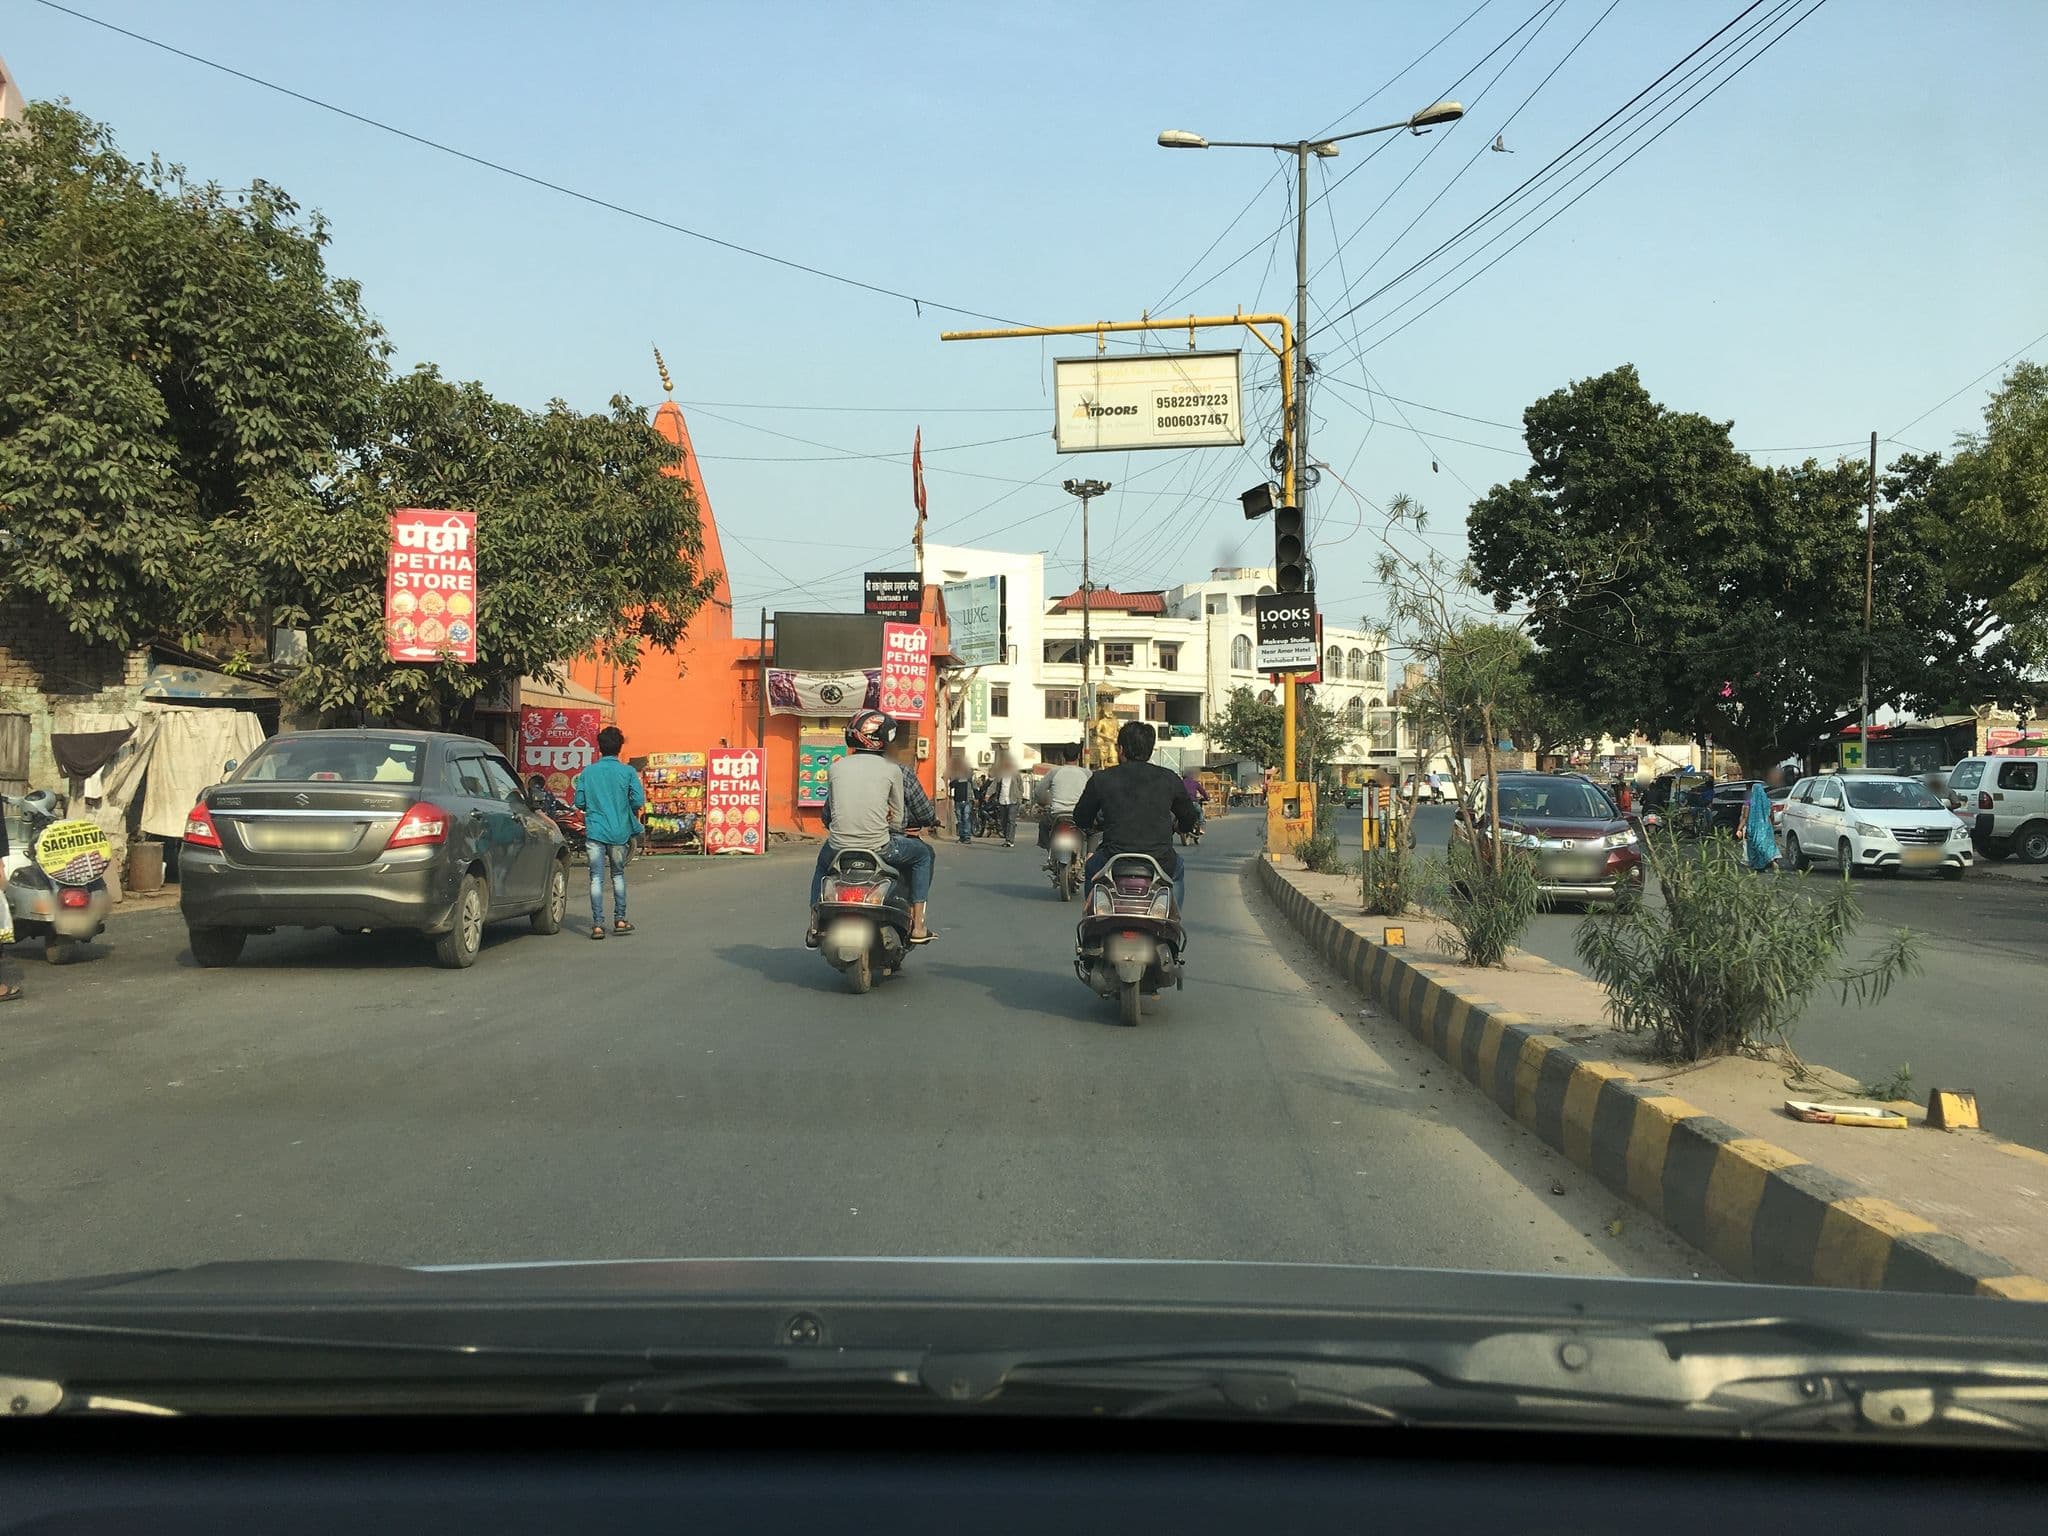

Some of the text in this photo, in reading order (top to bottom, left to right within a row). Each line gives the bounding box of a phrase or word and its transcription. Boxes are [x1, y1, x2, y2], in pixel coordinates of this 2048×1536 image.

[1156, 394, 1229, 408] 9582297223
[1157, 413, 1229, 428] 8006037467
[393, 552, 474, 571] PETHA
[393, 572, 473, 590] STORE
[963, 606, 989, 625] LUXE
[1260, 608, 1310, 622] LOOKS
[1261, 621, 1311, 630] SALON
[886, 651, 928, 664] PETHA
[886, 663, 927, 677] STORE
[709, 780, 761, 791] PETHA
[709, 794, 761, 806] STORE
[42, 830, 108, 853] SACHDEVA
